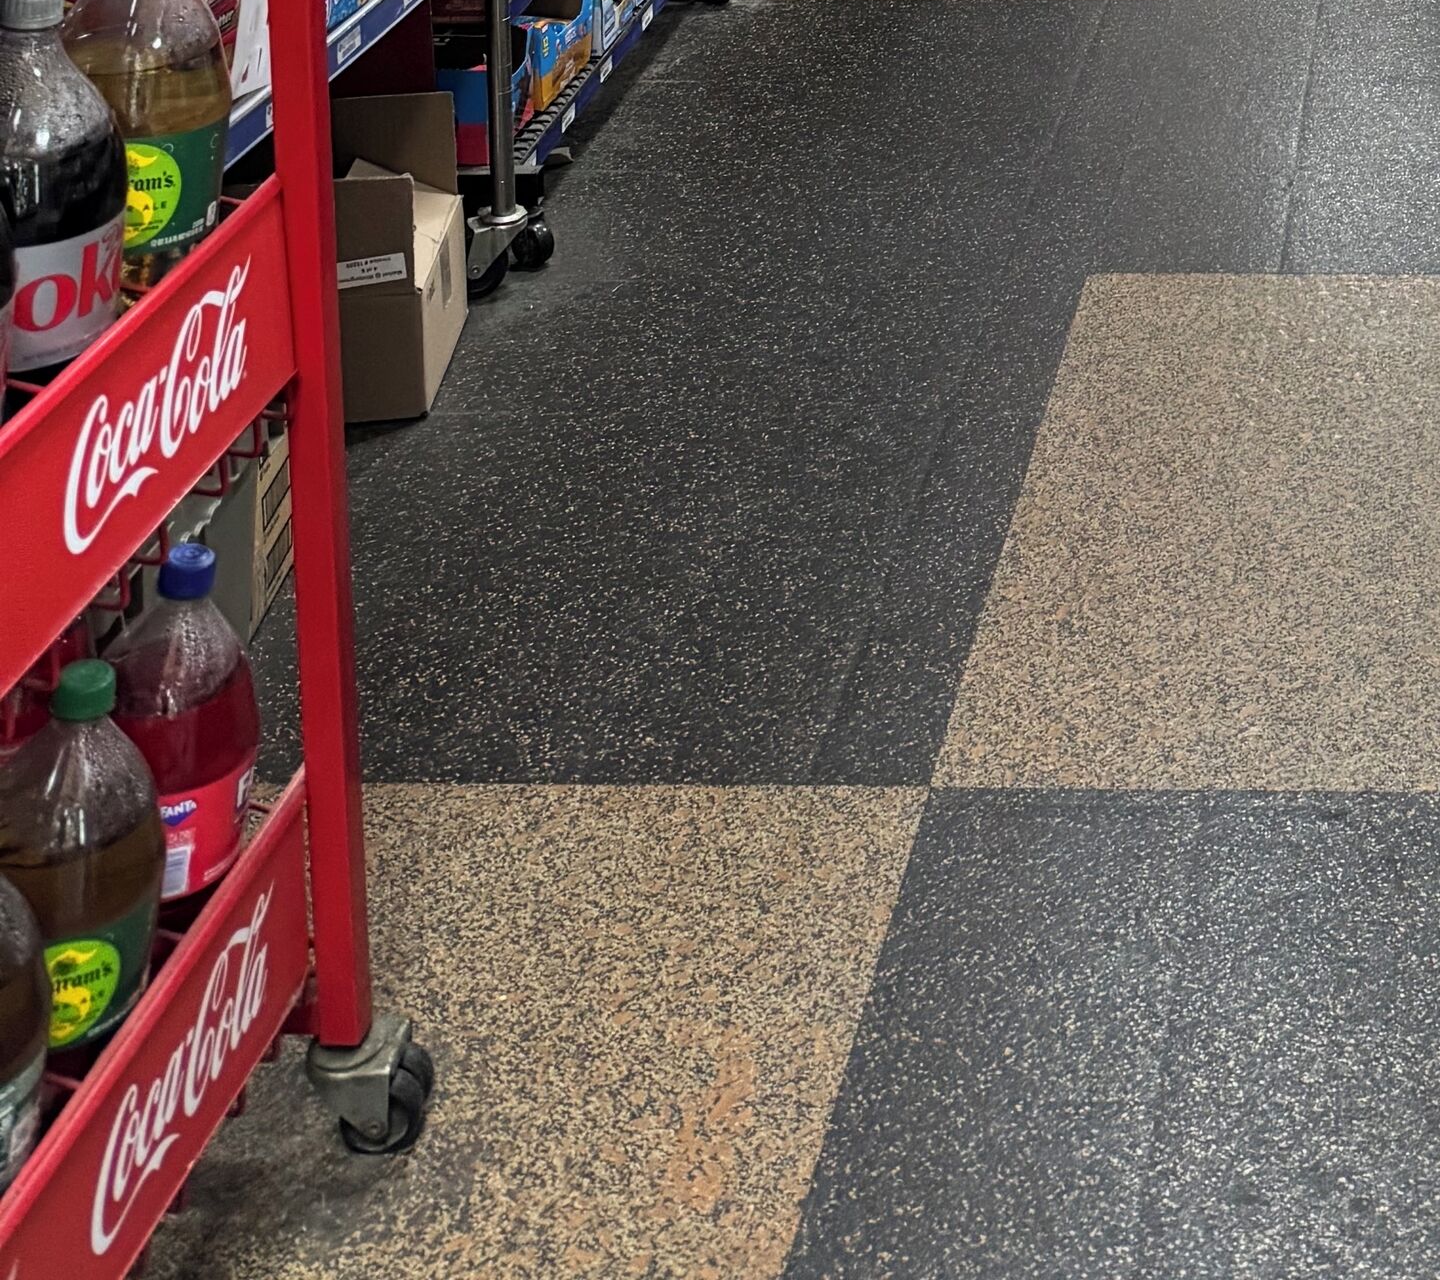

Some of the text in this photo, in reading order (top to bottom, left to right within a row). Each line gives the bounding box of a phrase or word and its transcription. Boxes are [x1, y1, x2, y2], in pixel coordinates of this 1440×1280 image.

[143, 199, 169, 212] ALE
[63, 254, 251, 555] Coca-Cola
[90, 879, 275, 1257] Coca-Cola
